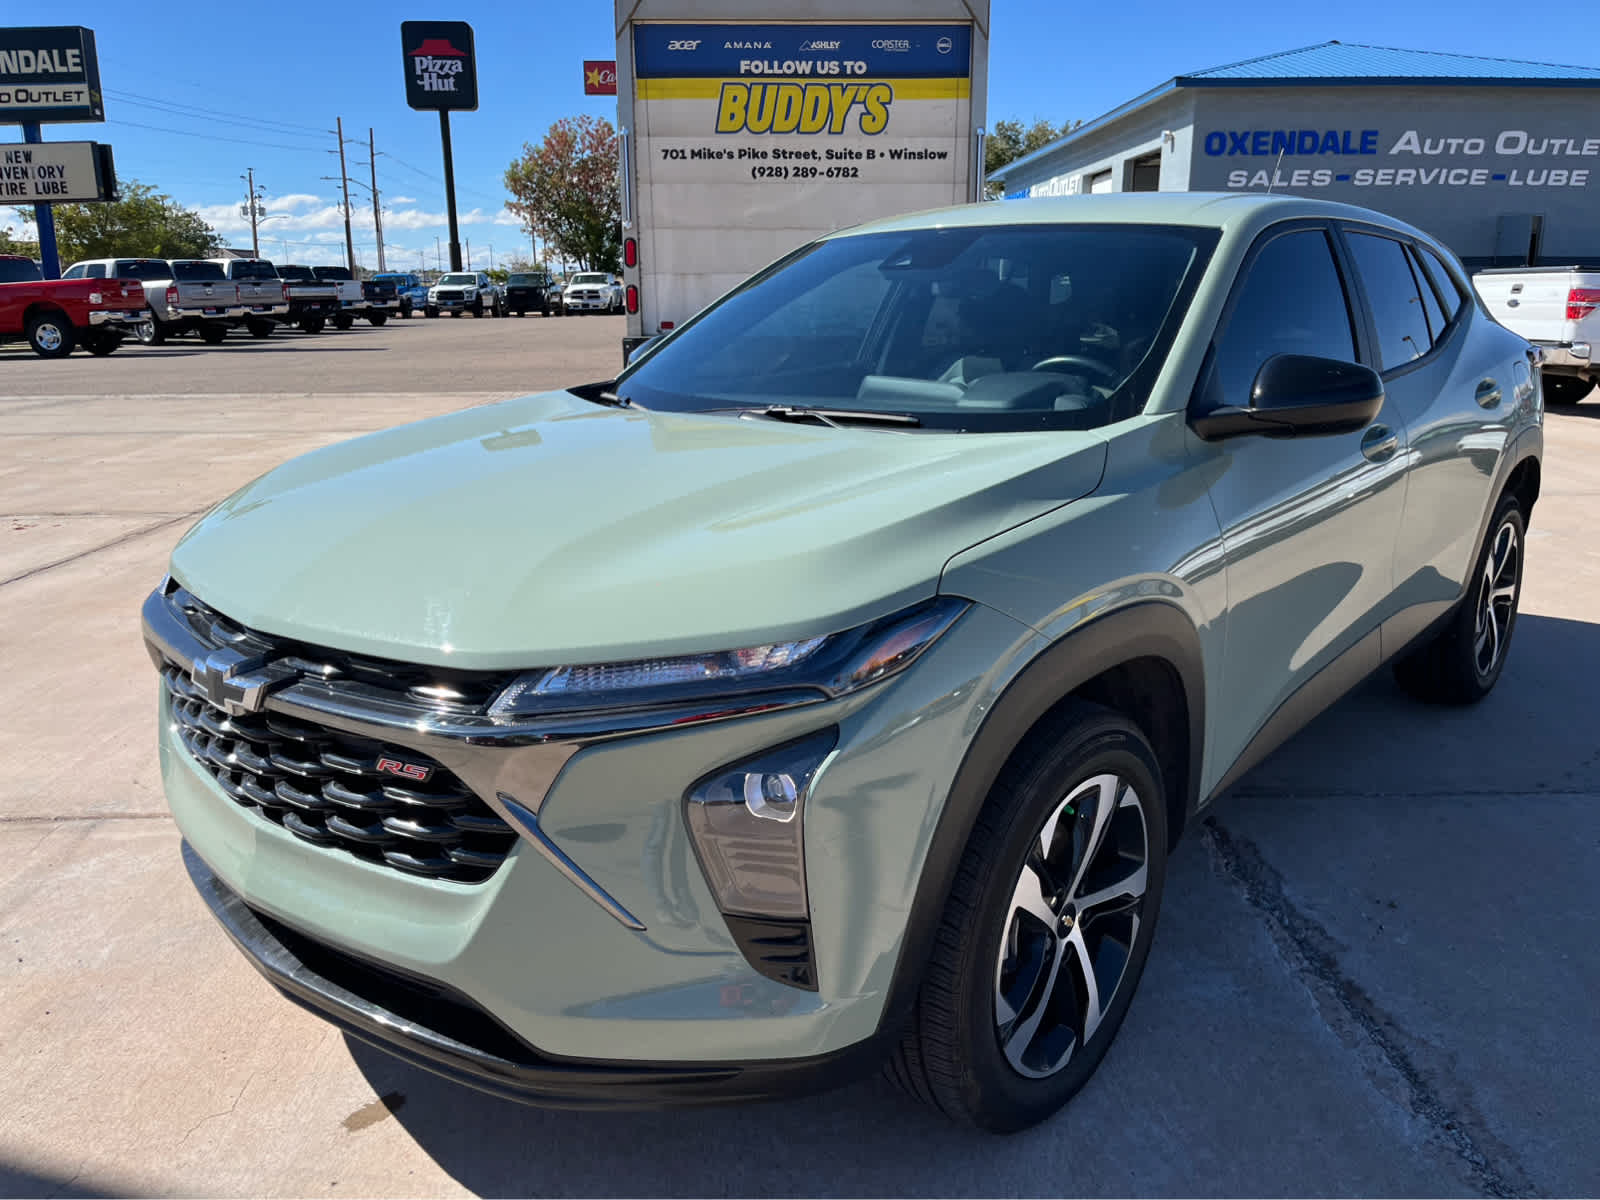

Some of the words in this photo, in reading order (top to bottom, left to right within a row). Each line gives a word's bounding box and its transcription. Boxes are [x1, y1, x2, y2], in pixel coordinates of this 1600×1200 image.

[667, 40, 702, 50] acer
[723, 41, 772, 49] AMANA
[810, 40, 841, 49] ASHLEY
[414, 56, 464, 76] Pizza
[739, 60, 813, 75] FOLLOW
[816, 60, 840, 75] US
[843, 61, 868, 75] TO
[417, 73, 457, 92] Hut
[15, 88, 84, 103] OUTLET
[715, 82, 894, 136] BUDDY'S
[1204, 130, 1380, 157] OXENDALE
[1388, 130, 1486, 155] AUTO
[5, 150, 33, 164] NEW
[661, 149, 688, 161] 701
[690, 148, 735, 161] Mike's
[738, 148, 769, 161] Pike
[772, 148, 822, 162] Street,
[825, 148, 863, 161] Suite
[866, 149, 877, 160] B
[889, 148, 949, 161] Winslow
[751, 166, 789, 180] (928)
[792, 166, 860, 179] 289-6782
[35, 180, 69, 195] LUBE
[376, 758, 430, 780] RS
